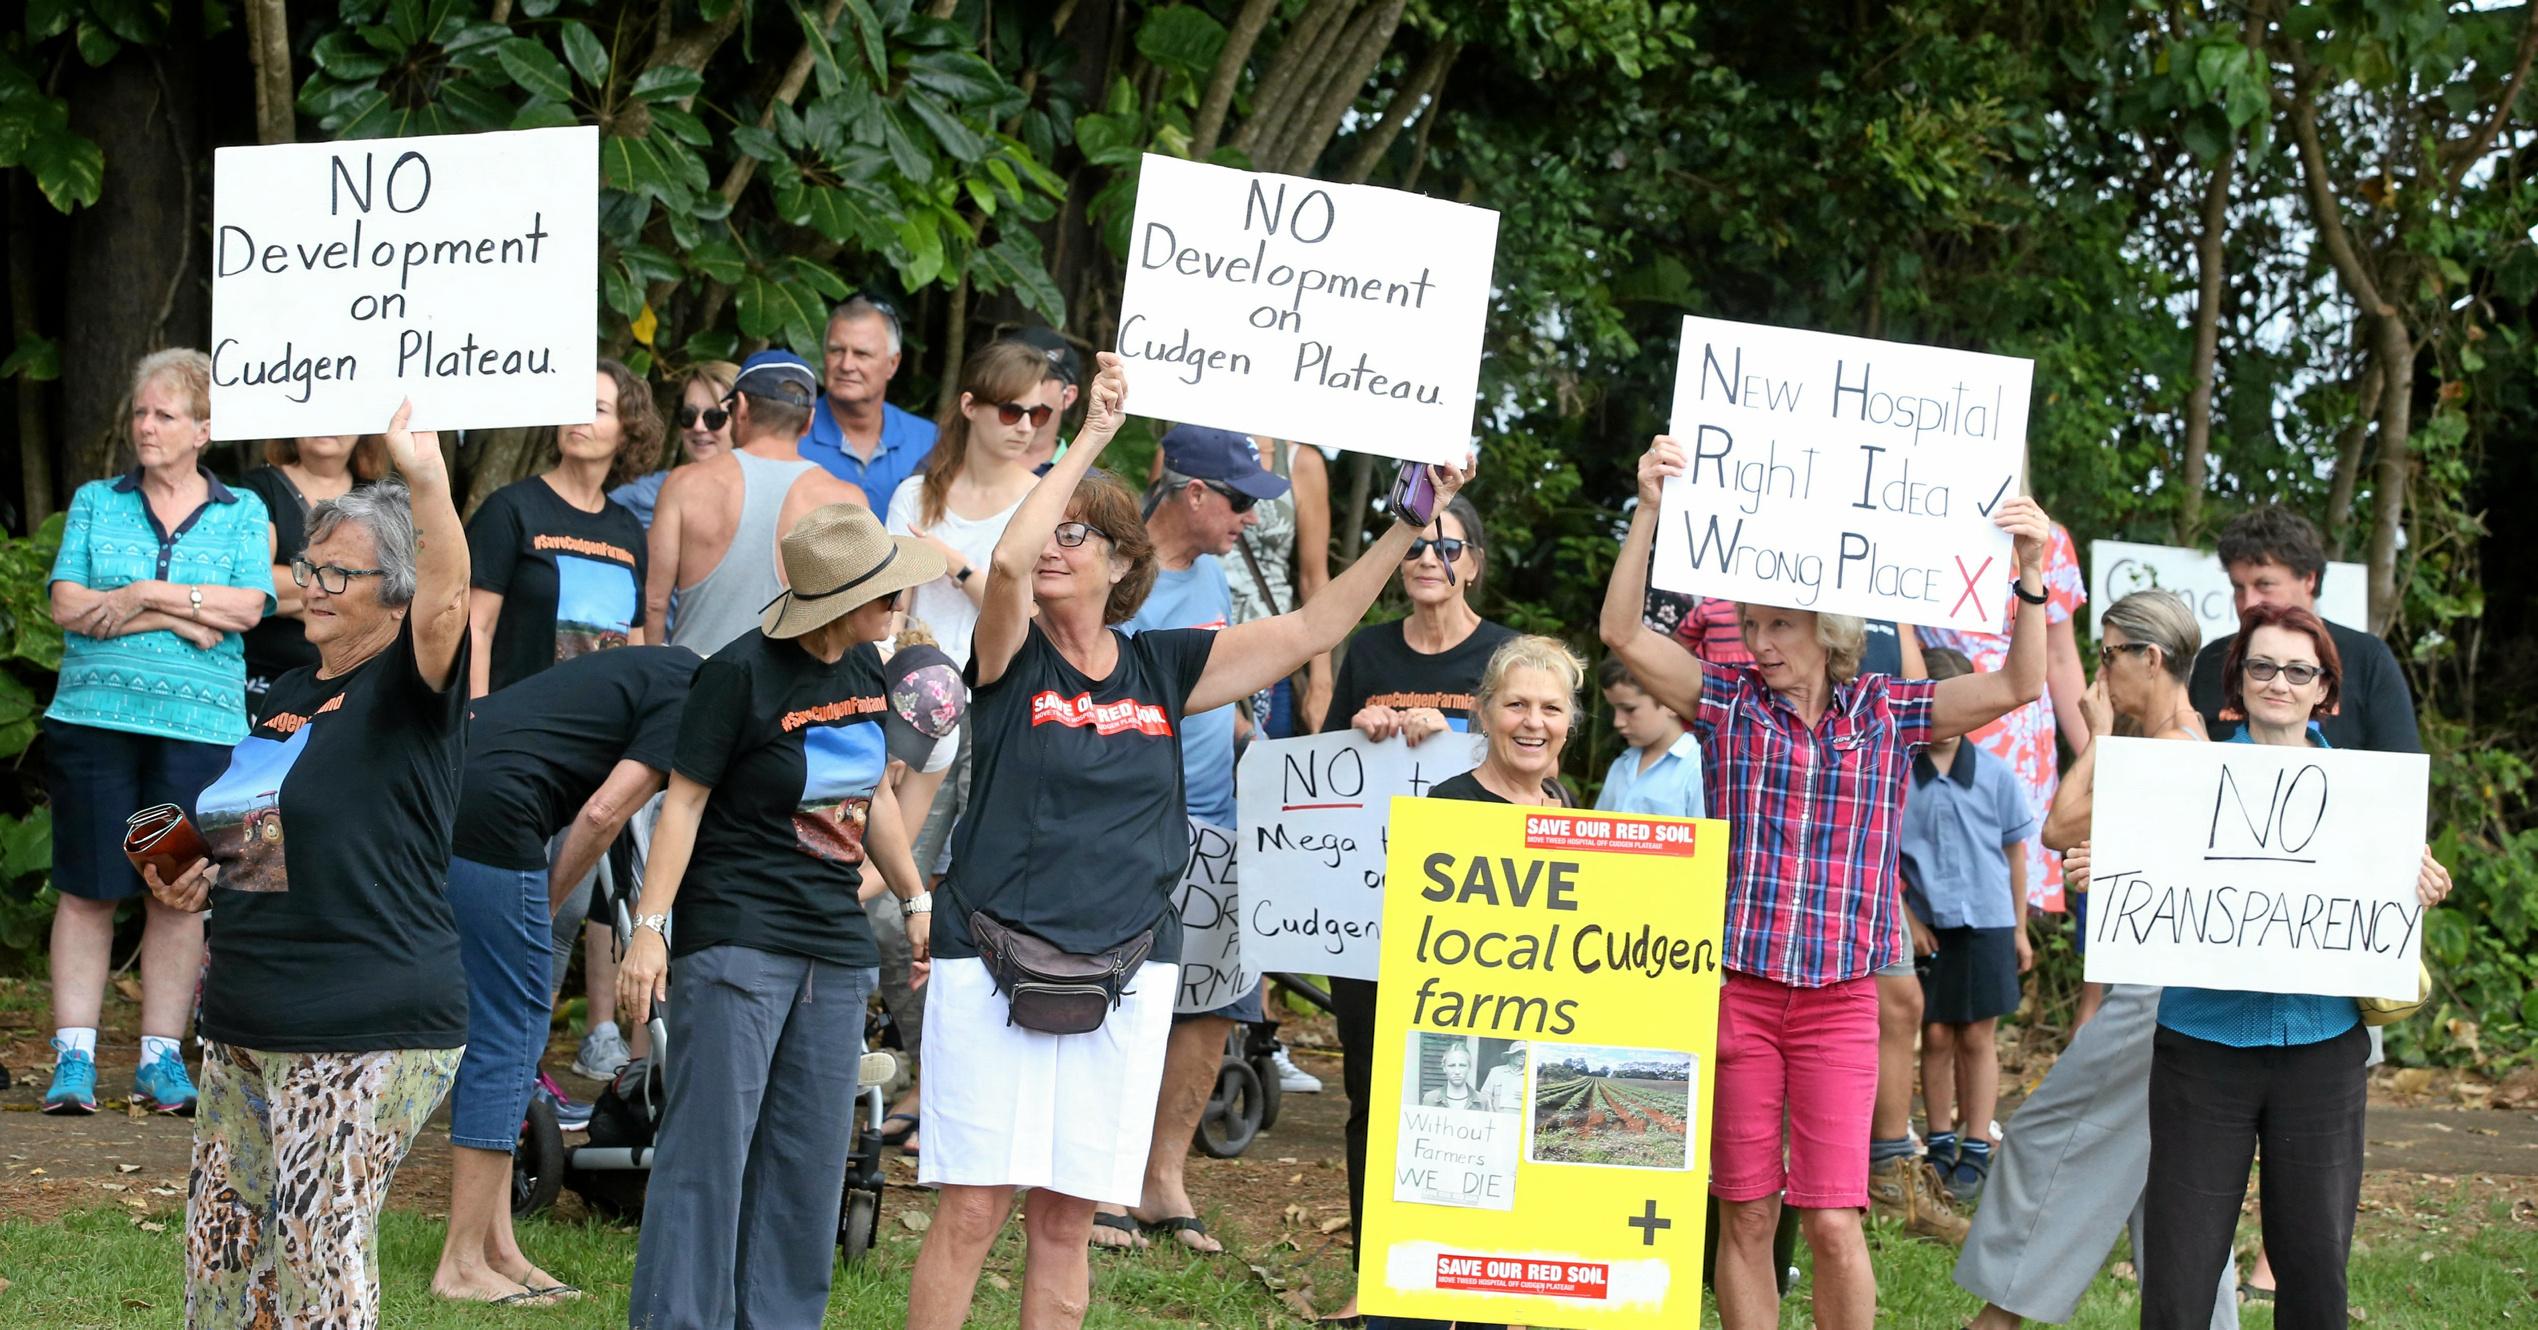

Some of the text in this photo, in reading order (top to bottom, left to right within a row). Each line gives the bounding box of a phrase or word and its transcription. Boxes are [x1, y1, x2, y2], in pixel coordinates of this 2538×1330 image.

[331, 150, 432, 216] NO
[1243, 178, 1336, 244] NO
[218, 211, 549, 290] Development
[1141, 221, 1436, 311] Development
[350, 293, 406, 321] on
[1248, 305, 1301, 334] on
[212, 328, 557, 404] Cudgen Plateau.
[1117, 314, 1444, 406] Cudgen Plateau.
[1832, 358, 2002, 446] Hospital
[1691, 423, 1821, 515] Right
[1034, 693, 1074, 717] SAVE
[1096, 702, 1134, 723] RED
[1283, 746, 1365, 804] NO
[1526, 817, 1694, 844] SAVE OUR RED SOIL
[2207, 763, 2328, 854] NO
[1256, 822, 1358, 869] Mega
[1526, 836, 1545, 844] MOVE
[1420, 851, 1580, 912] SAVE
[1252, 899, 1379, 956] Cudgen
[2092, 869, 2422, 960] TRANSPARENCY
[1416, 914, 1716, 979] local Cudgen
[1412, 976, 1580, 1036] farms
[1404, 1110, 1497, 1143] Without
[1413, 1137, 1486, 1167] Farmers
[1397, 1167, 1503, 1198] WE DIE
[1437, 1257, 1606, 1286] SAVE OUR RED SOIL
